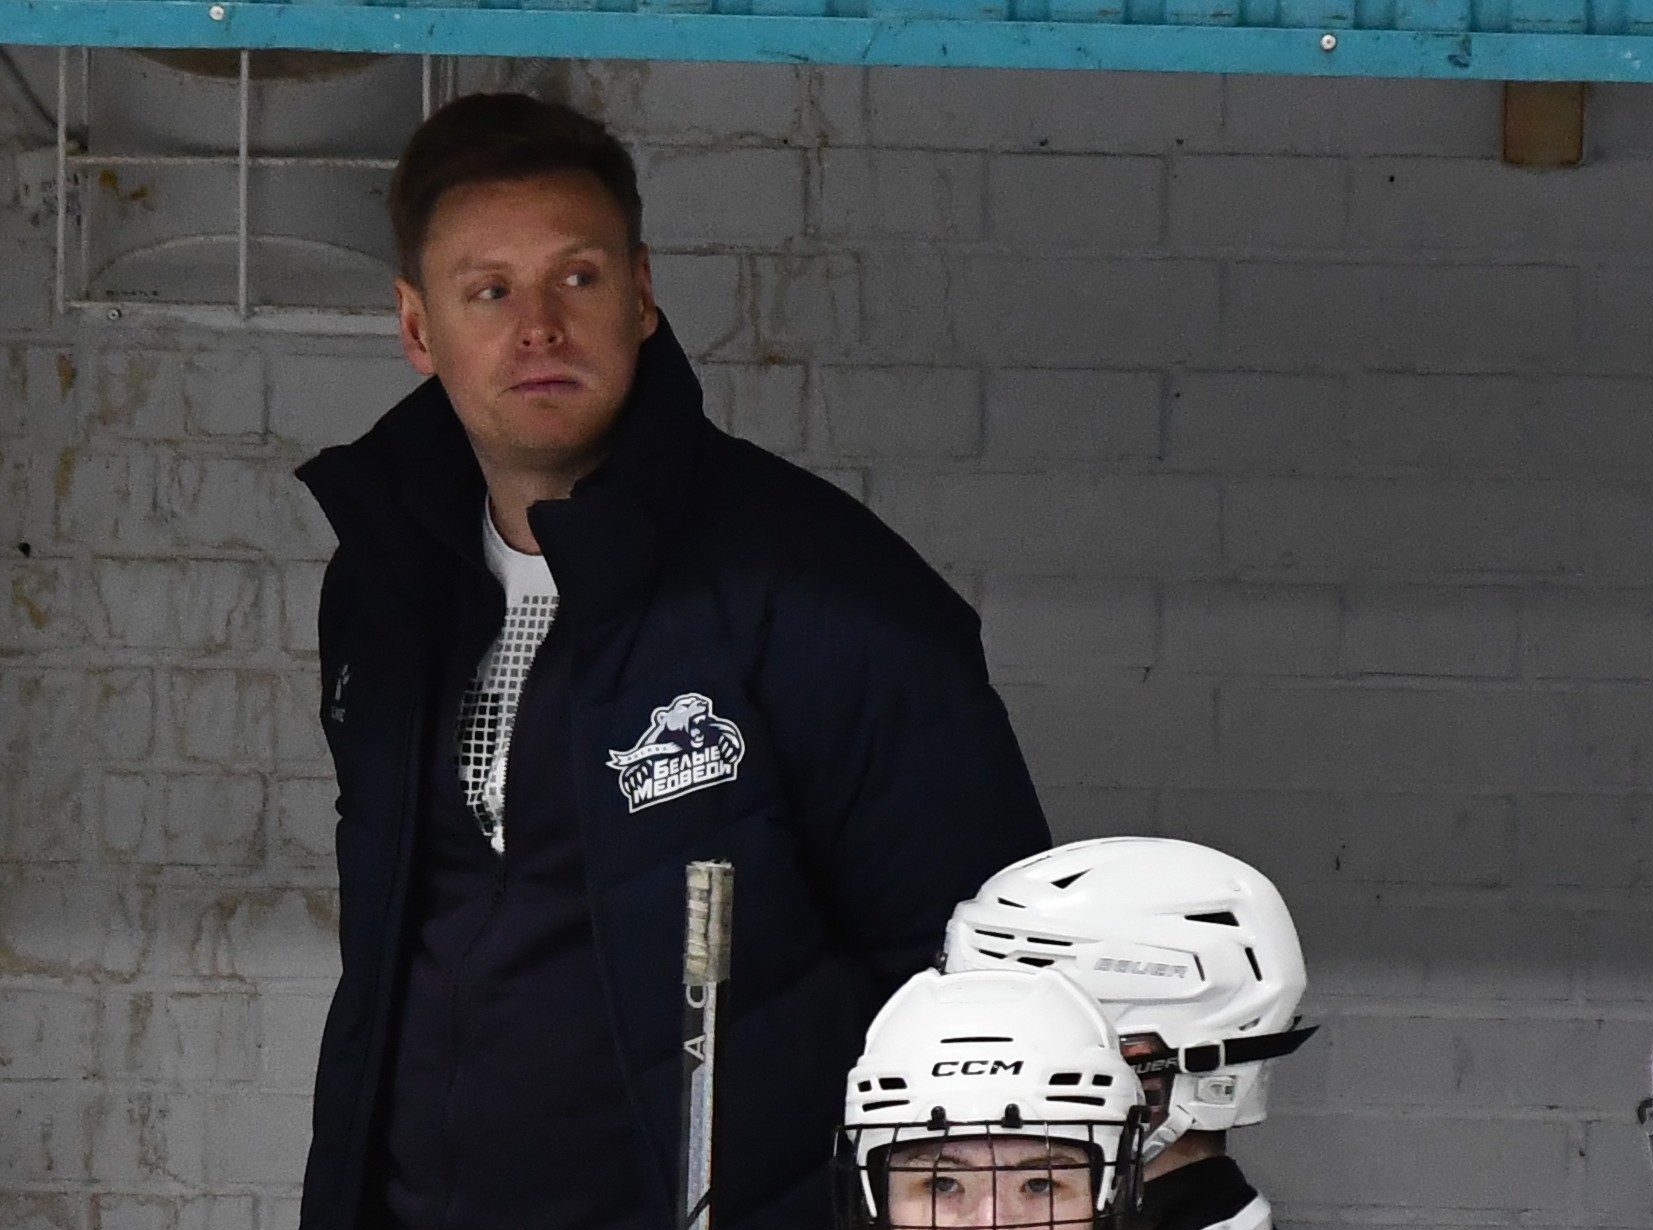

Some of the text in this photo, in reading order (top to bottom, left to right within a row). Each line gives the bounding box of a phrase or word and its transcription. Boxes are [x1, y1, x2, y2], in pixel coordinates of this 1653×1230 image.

[653, 746, 721, 781] БЕЛЫЕ
[633, 762, 732, 804] МЕДВЕДИ
[931, 1059, 1025, 1078] CCM
